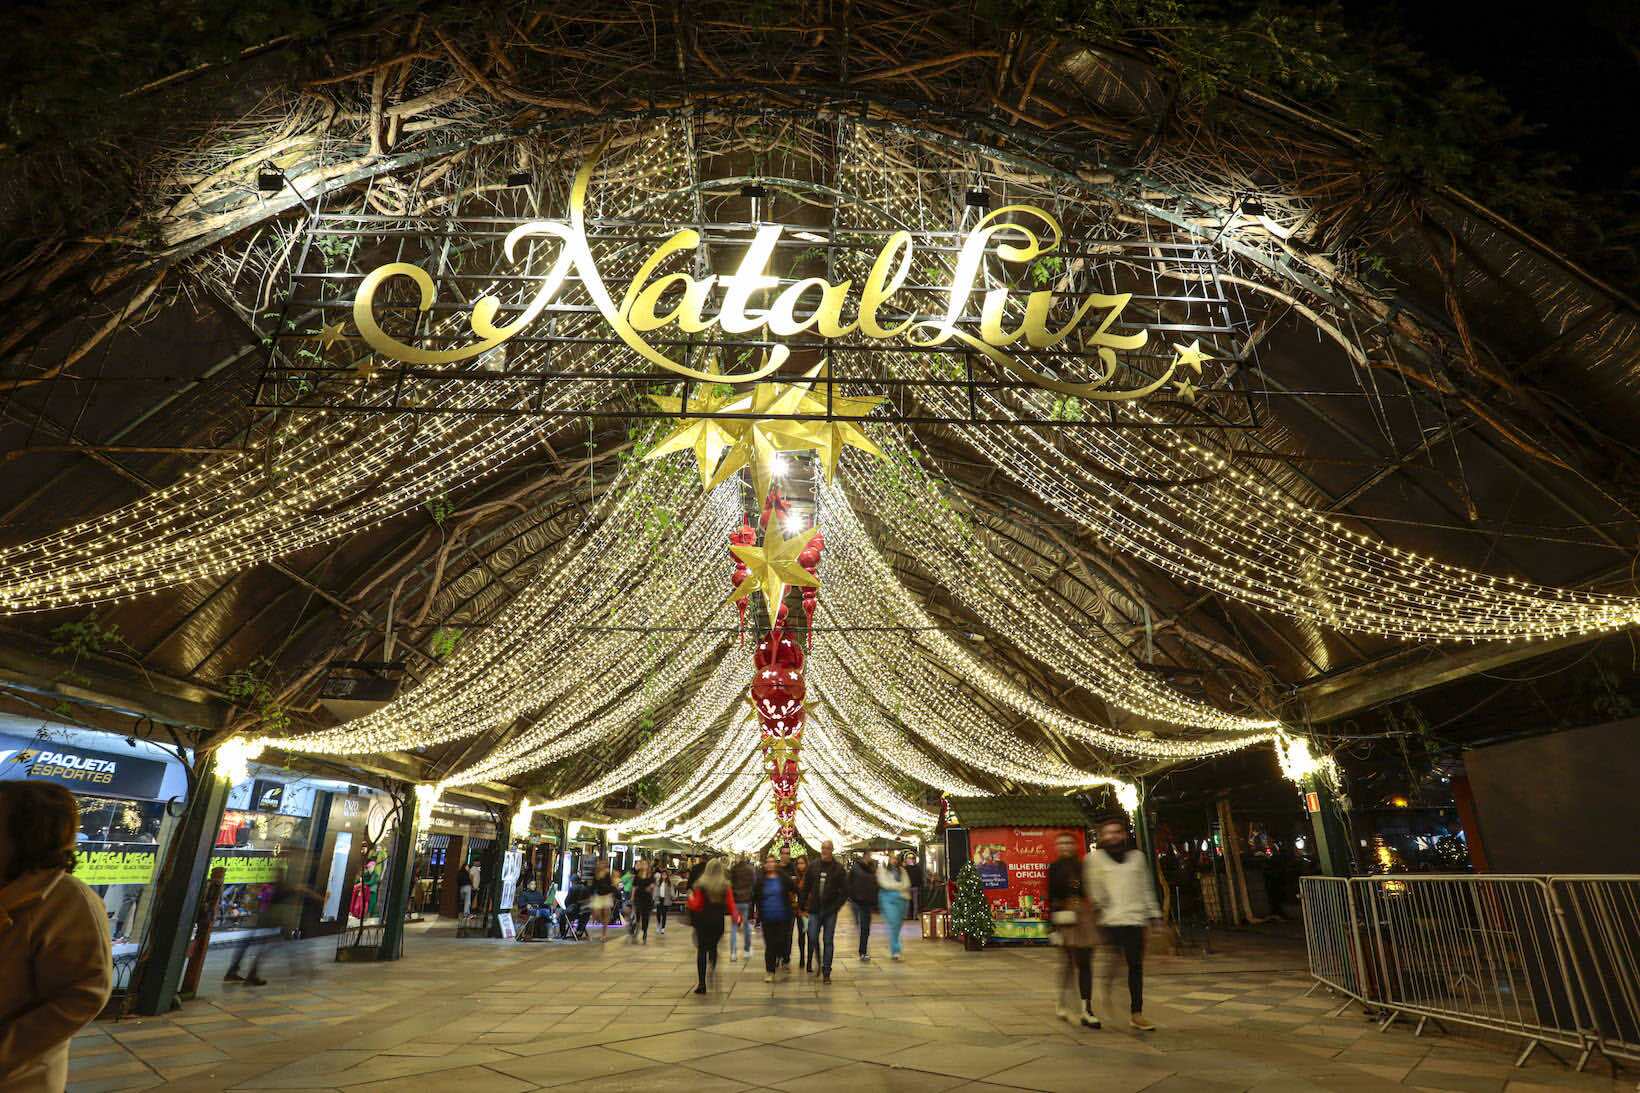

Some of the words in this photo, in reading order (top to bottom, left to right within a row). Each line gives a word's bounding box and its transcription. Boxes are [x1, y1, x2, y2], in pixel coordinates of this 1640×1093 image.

[354, 151, 912, 383] Natal
[908, 204, 1179, 401] Luz
[37, 751, 117, 774] PAQUETA
[31, 763, 113, 784] ESPORTES
[89, 851, 123, 865] MEGA
[124, 852, 155, 865] MEGA
[1015, 871, 1047, 879] OFICIAL
